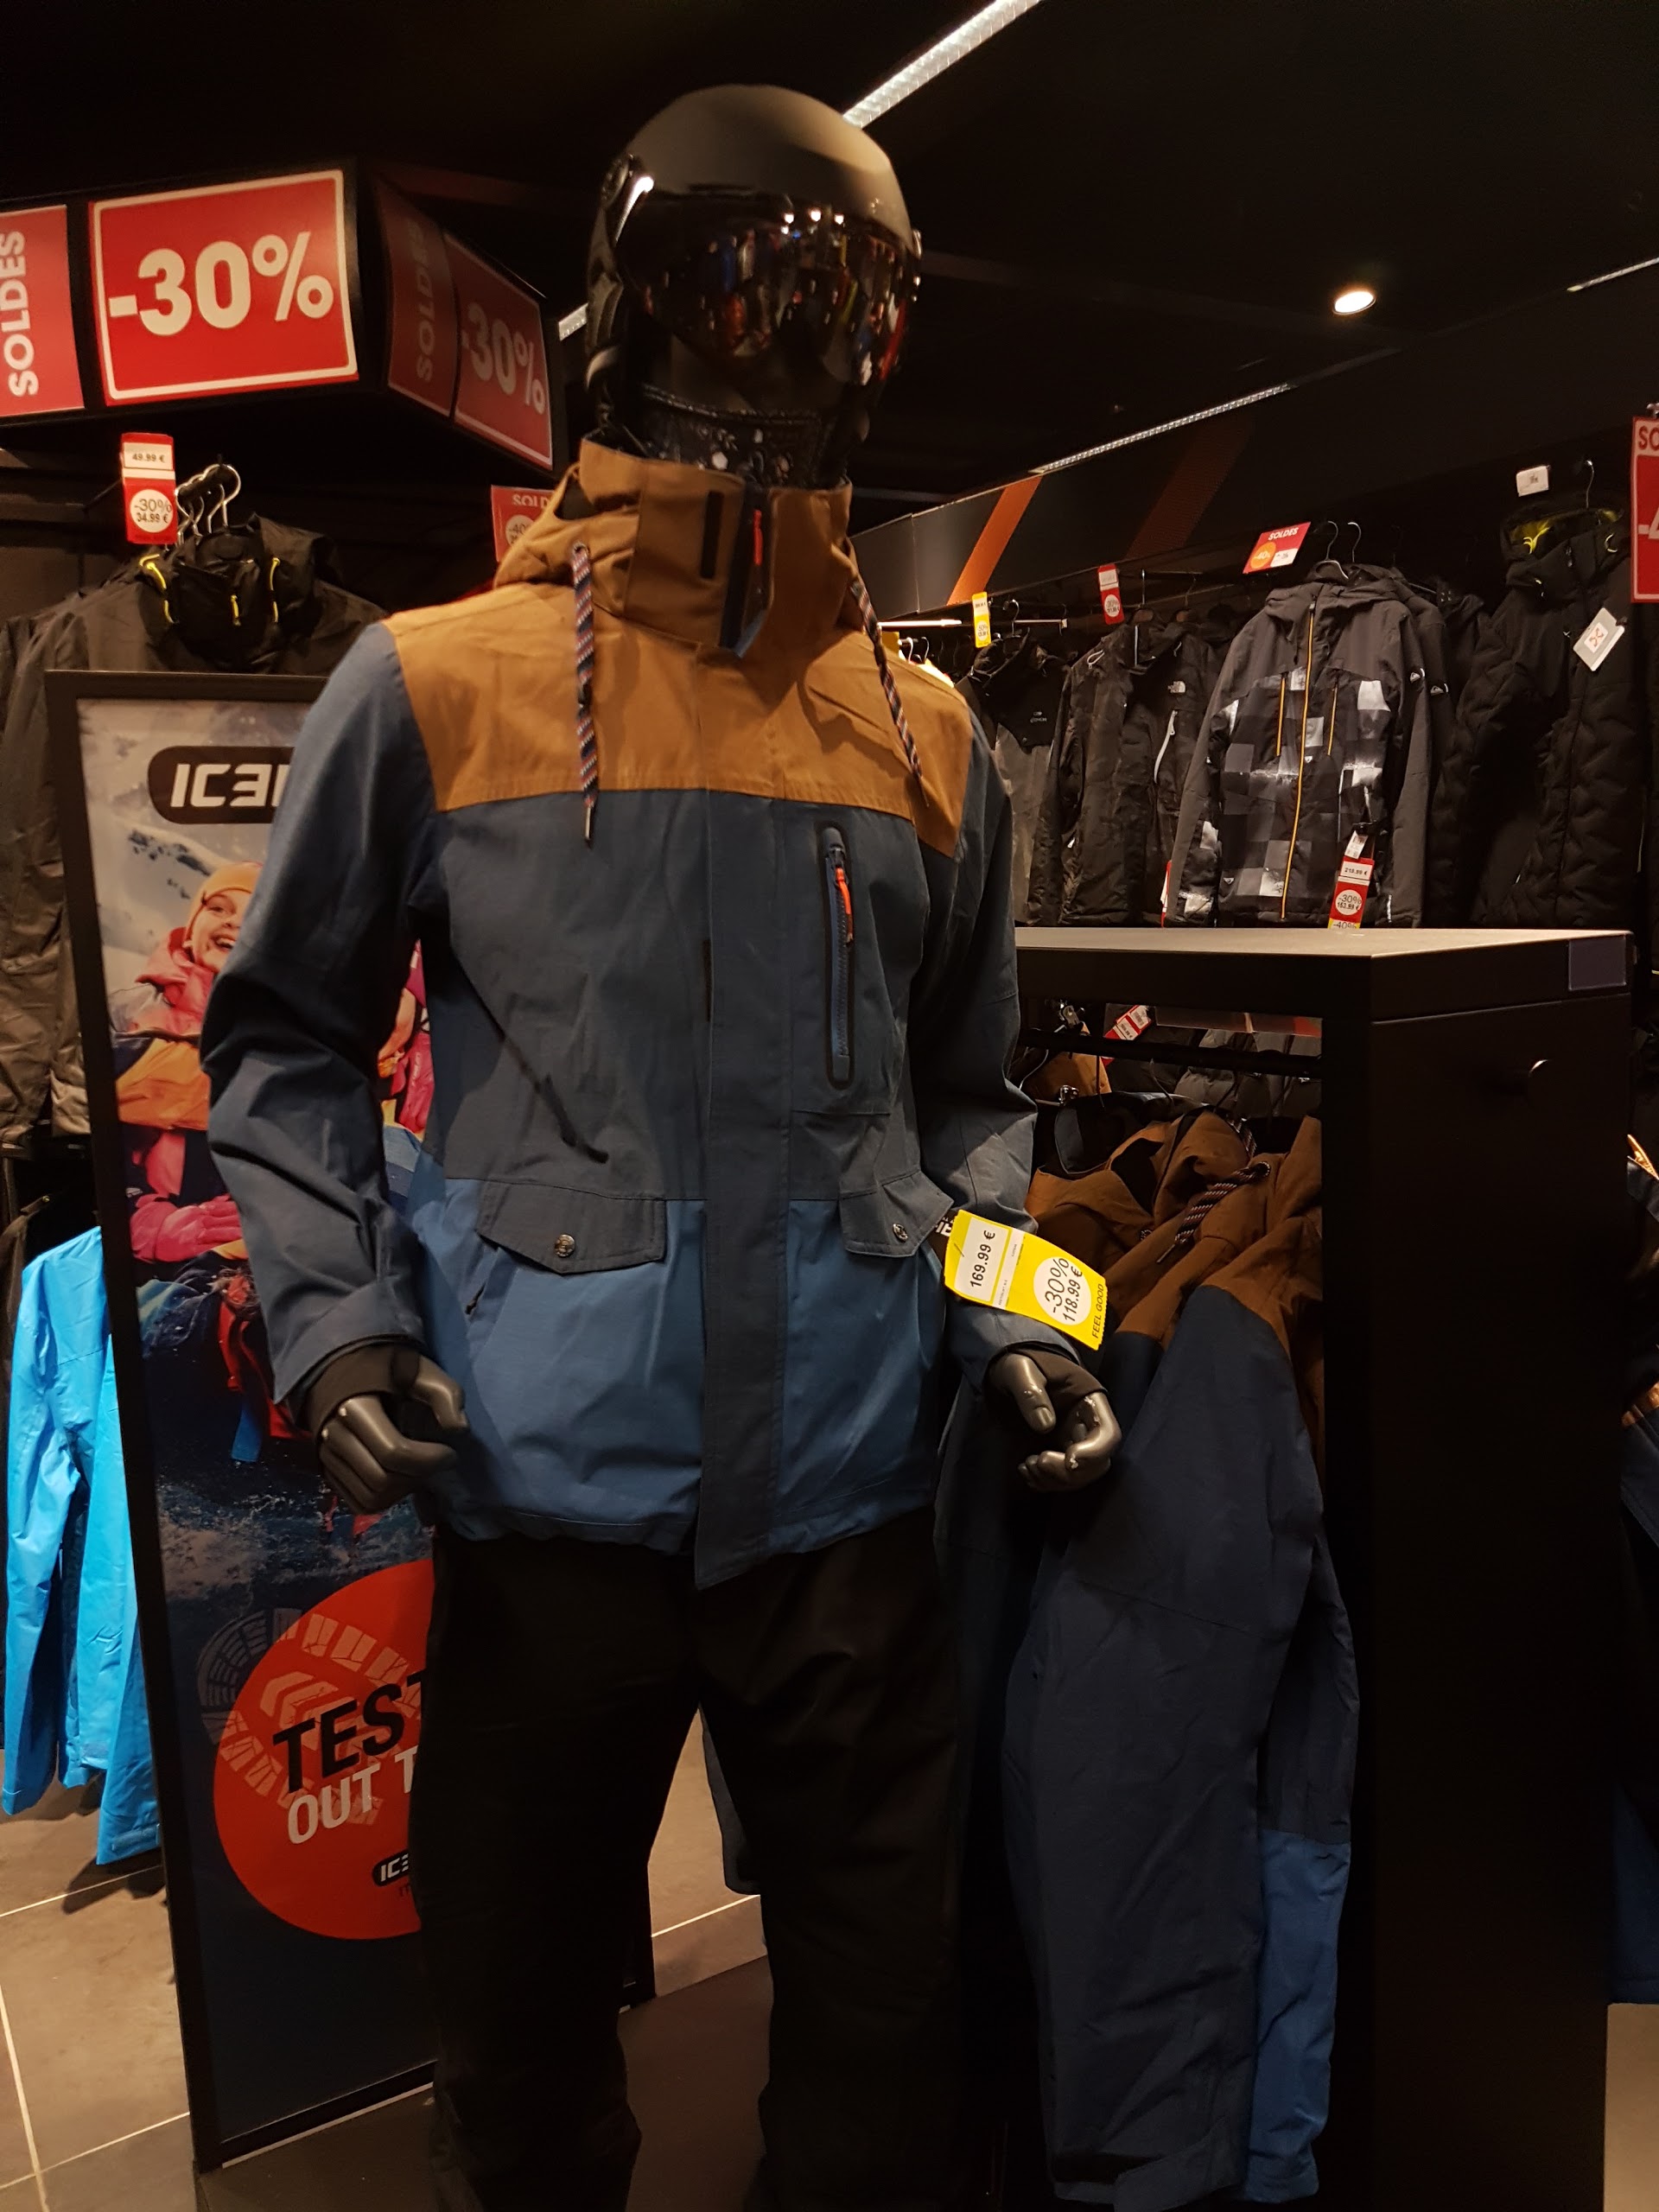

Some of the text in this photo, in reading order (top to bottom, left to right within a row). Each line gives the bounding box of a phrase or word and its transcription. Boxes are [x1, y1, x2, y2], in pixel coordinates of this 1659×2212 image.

[109, 231, 334, 336] -30%
[407, 218, 435, 383] SOLDES
[0, 231, 39, 397] SOLDES
[461, 304, 545, 415] -30%
[132, 454, 166, 463] 49.99 €
[134, 499, 172, 512] -30%
[1268, 527, 1299, 541] SOLDES
[1338, 894, 1362, 905] -30%
[970, 1230, 995, 1287] 169.99 €
[1045, 1257, 1070, 1313] -30%
[1063, 1265, 1083, 1322] 118.99 €
[1091, 1283, 1105, 1339] FEEL GOOD
[288, 1763, 381, 1845] OUT
